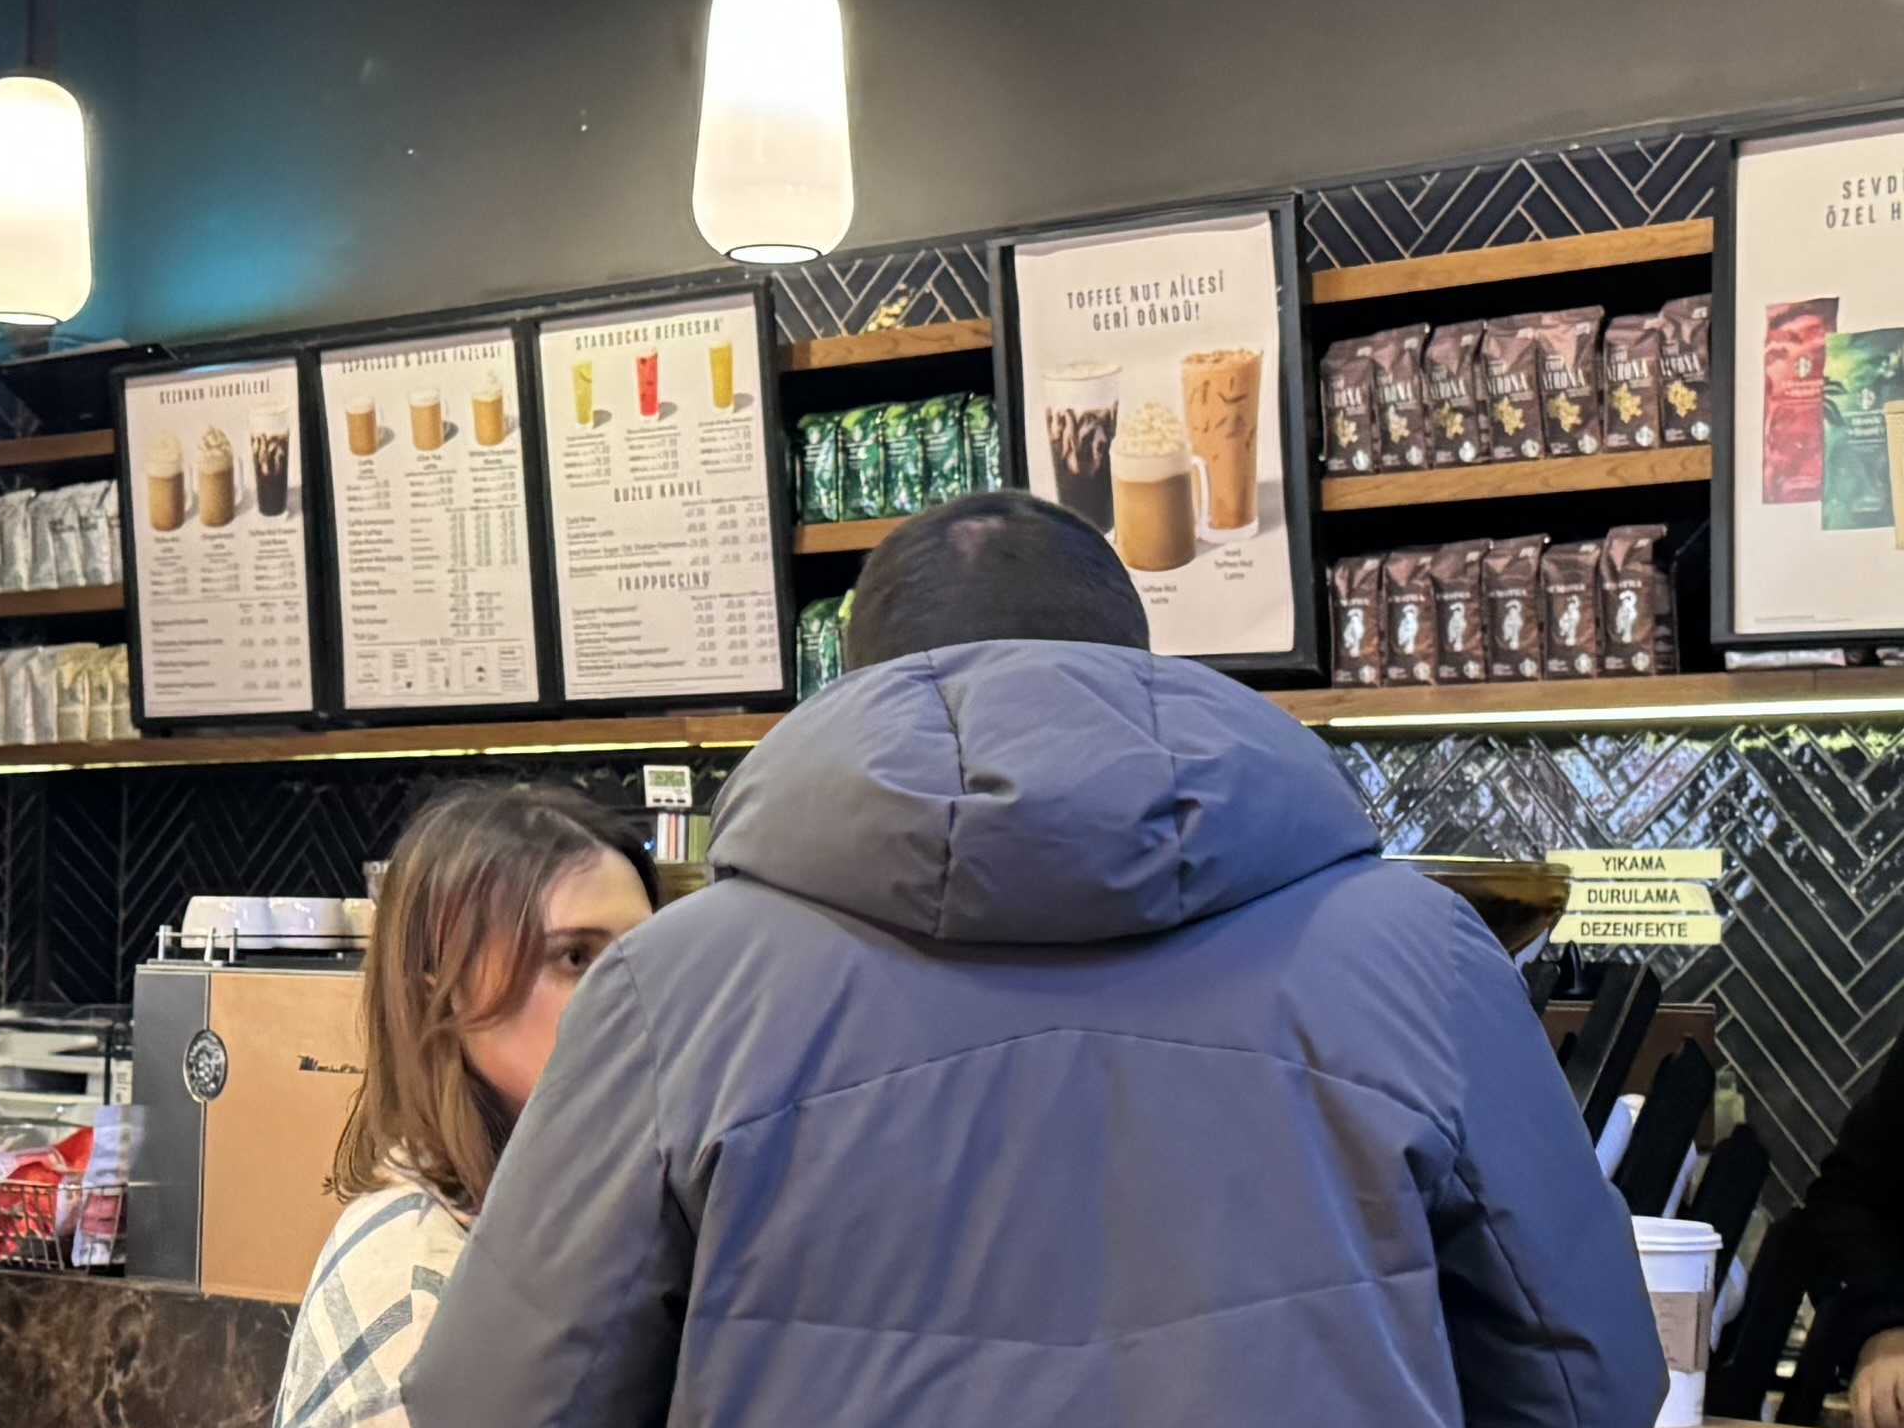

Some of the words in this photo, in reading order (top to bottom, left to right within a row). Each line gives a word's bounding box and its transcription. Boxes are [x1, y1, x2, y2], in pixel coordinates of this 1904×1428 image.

[1825, 204, 1877, 229] ÖZEL
[1067, 286, 1122, 309] TOFFEE
[1130, 282, 1161, 303] NUT
[1170, 270, 1225, 297] AİLESİ
[1093, 305, 1129, 331] GERİ
[1137, 300, 1200, 327] DÖNDÜ!
[575, 328, 649, 351] STARBUCKS
[1601, 854, 1666, 873] YIKAMA
[1586, 888, 1681, 906] DURULAMA
[1580, 919, 1689, 940] DEZENFEKTE
